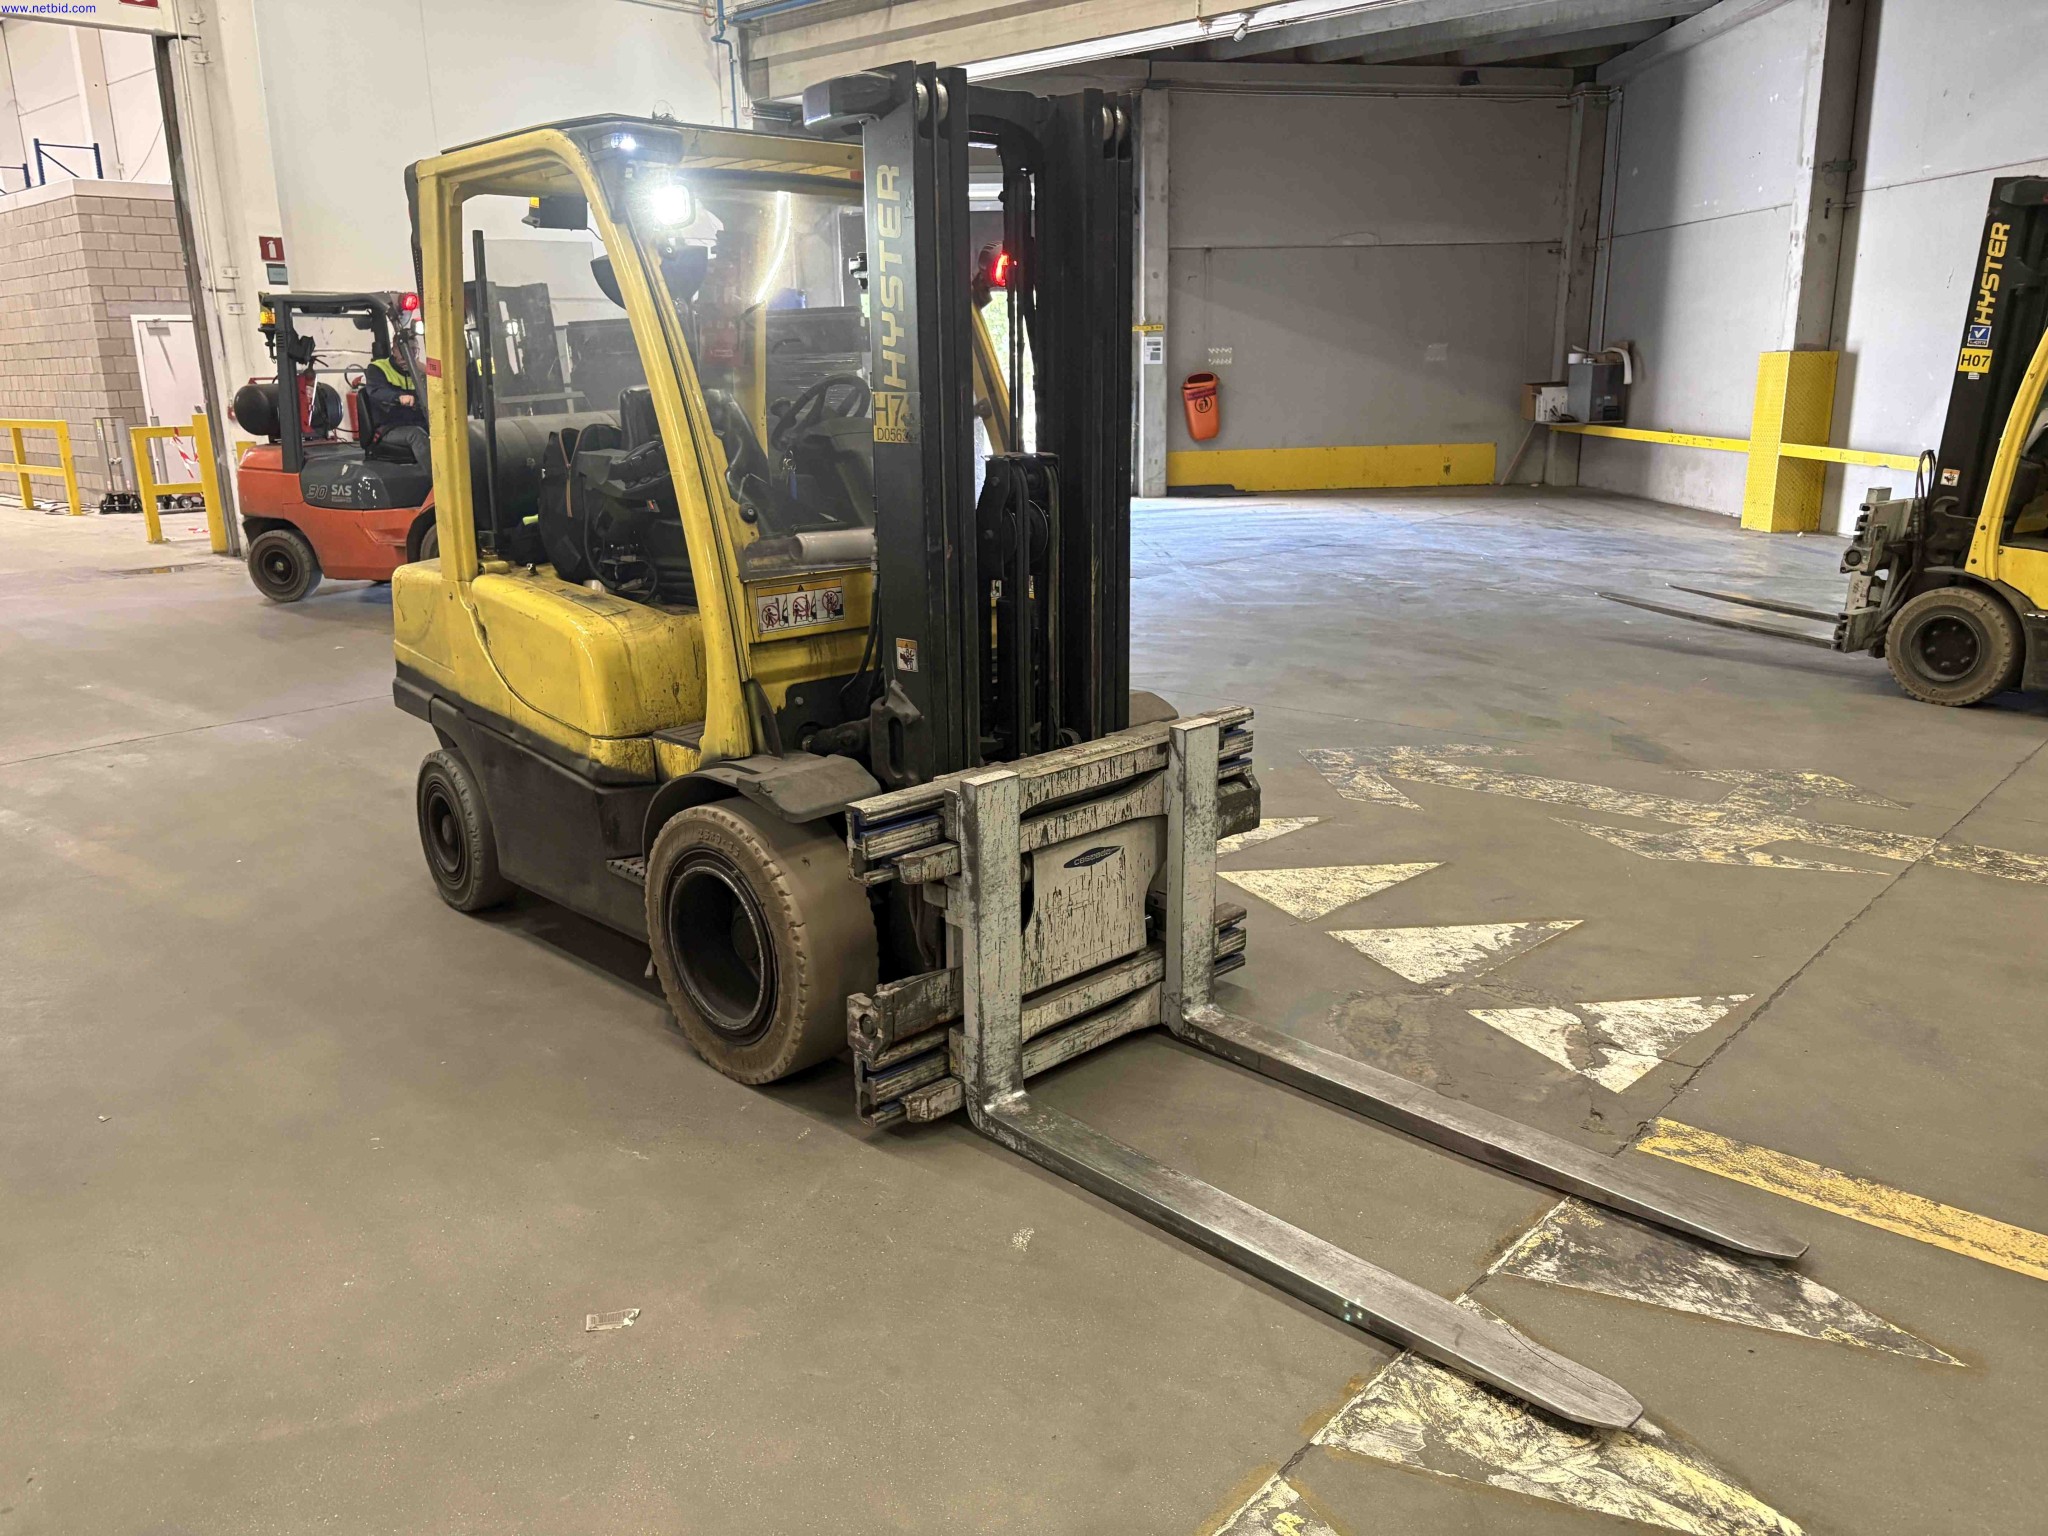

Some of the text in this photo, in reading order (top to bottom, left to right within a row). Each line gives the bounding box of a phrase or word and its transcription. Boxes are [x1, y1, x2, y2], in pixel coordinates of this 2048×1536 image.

[877, 164, 907, 390] HYSTER
[1974, 222, 2010, 325] HYSTER
[1960, 354, 1990, 368] H07
[873, 394, 909, 427] H7
[331, 484, 352, 497] SAS
